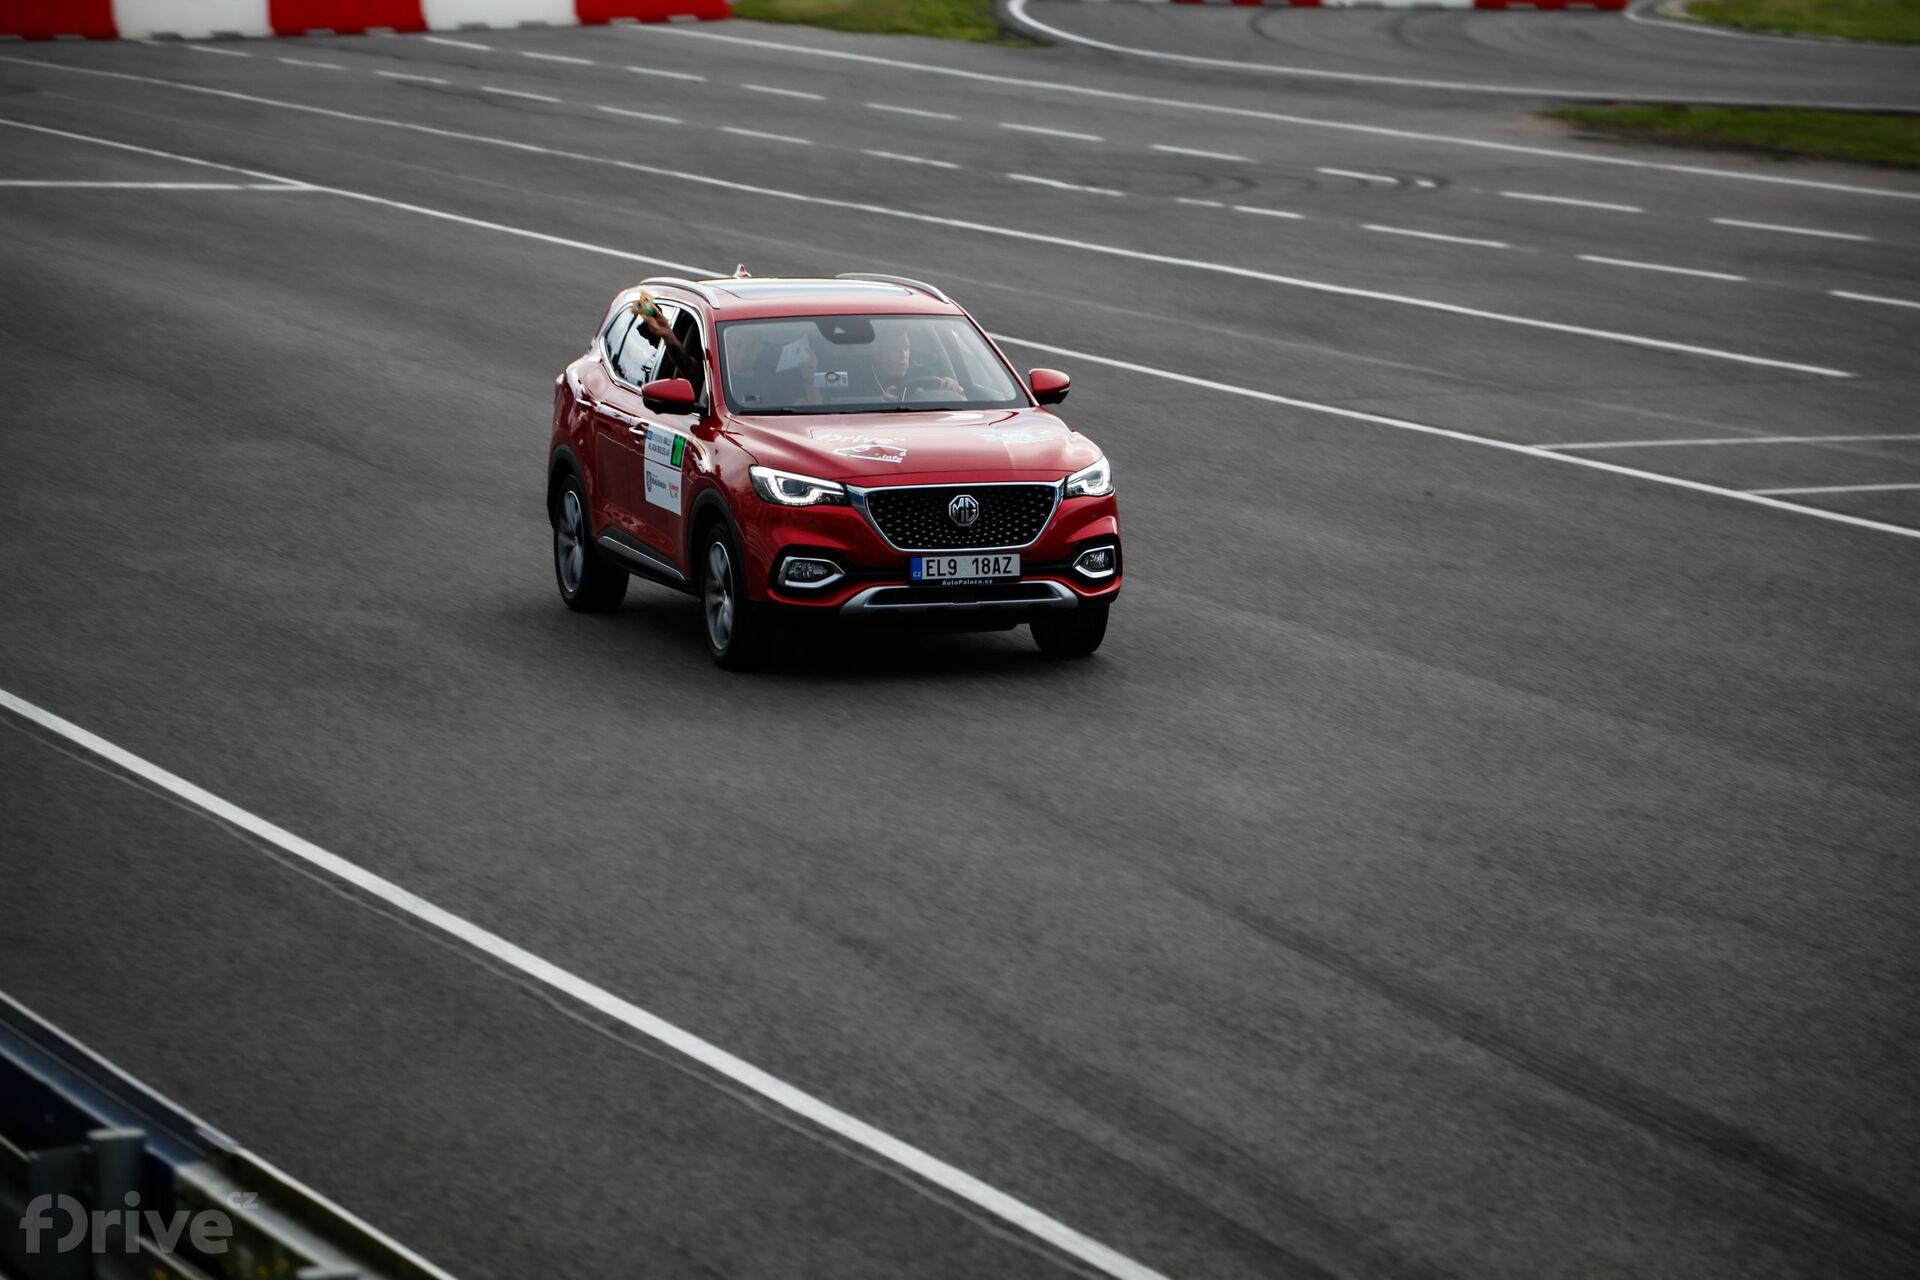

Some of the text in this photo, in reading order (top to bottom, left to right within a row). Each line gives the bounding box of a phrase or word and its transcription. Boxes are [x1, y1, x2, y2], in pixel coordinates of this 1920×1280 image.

[952, 497, 977, 523] MG
[926, 556, 1012, 577] EL9 18AZ
